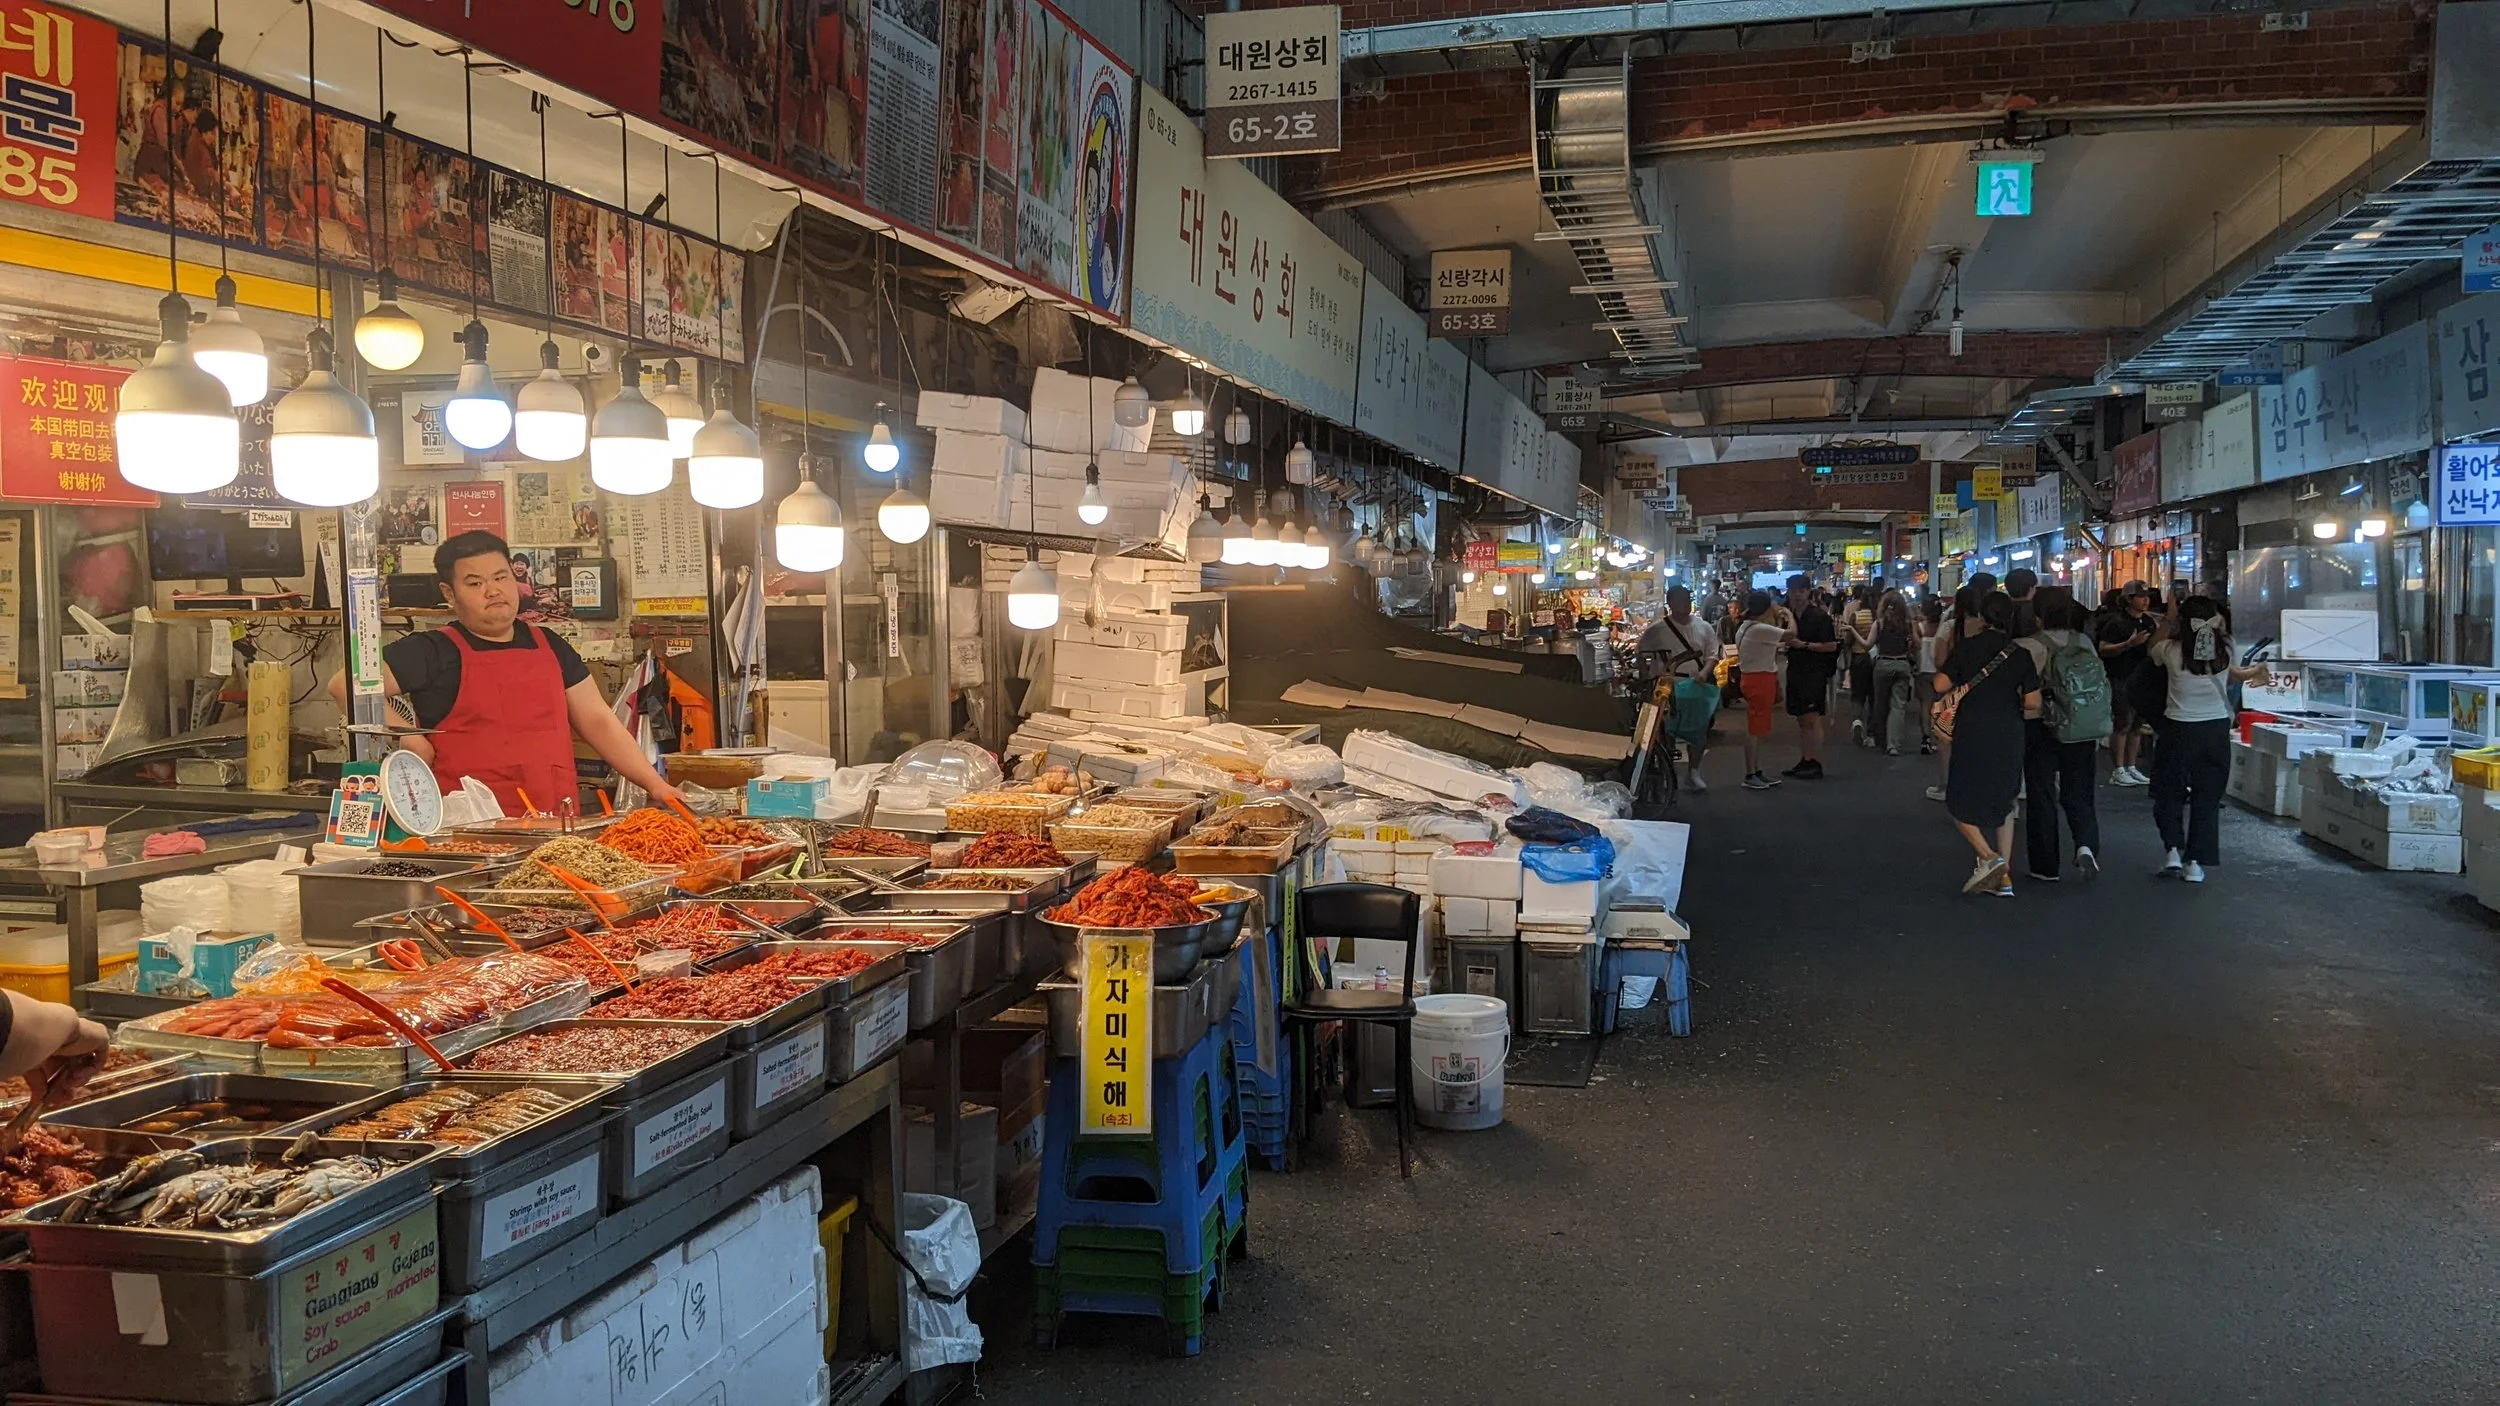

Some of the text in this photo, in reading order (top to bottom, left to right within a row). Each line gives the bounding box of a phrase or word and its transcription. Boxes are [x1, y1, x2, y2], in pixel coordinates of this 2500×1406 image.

[1219, 36, 1327, 71] 대원상회
[1229, 81, 1317, 100] 2267-1415
[1228, 112, 1318, 143] 65-2호
[1179, 186, 1297, 338] 대원상회
[1438, 268, 1505, 288] 신랑각시
[1442, 294, 1497, 305] 2272-0096
[1441, 312, 1497, 330] 65-3호
[1372, 317, 1421, 409] 신랑각시
[1561, 416, 1586, 427] 66호
[2160, 406, 2187, 418] 40호
[2271, 368, 2361, 453] 삼우수산
[49, 440, 113, 462] 真空包装
[58, 471, 106, 492] 谢谢你
[2247, 672, 2298, 690] 장어
[1103, 945, 1130, 1107] 가자미식해
[1101, 1113, 1132, 1126] [속초]
[509, 1184, 577, 1219] Shrimp with soy sauce
[304, 1231, 400, 1294] 간장게장
[392, 1240, 435, 1275] Gejang
[304, 1322, 329, 1342] Soy
[335, 1301, 371, 1328] sauce
[386, 1259, 436, 1300] marinated
[306, 1338, 339, 1364] Crab
